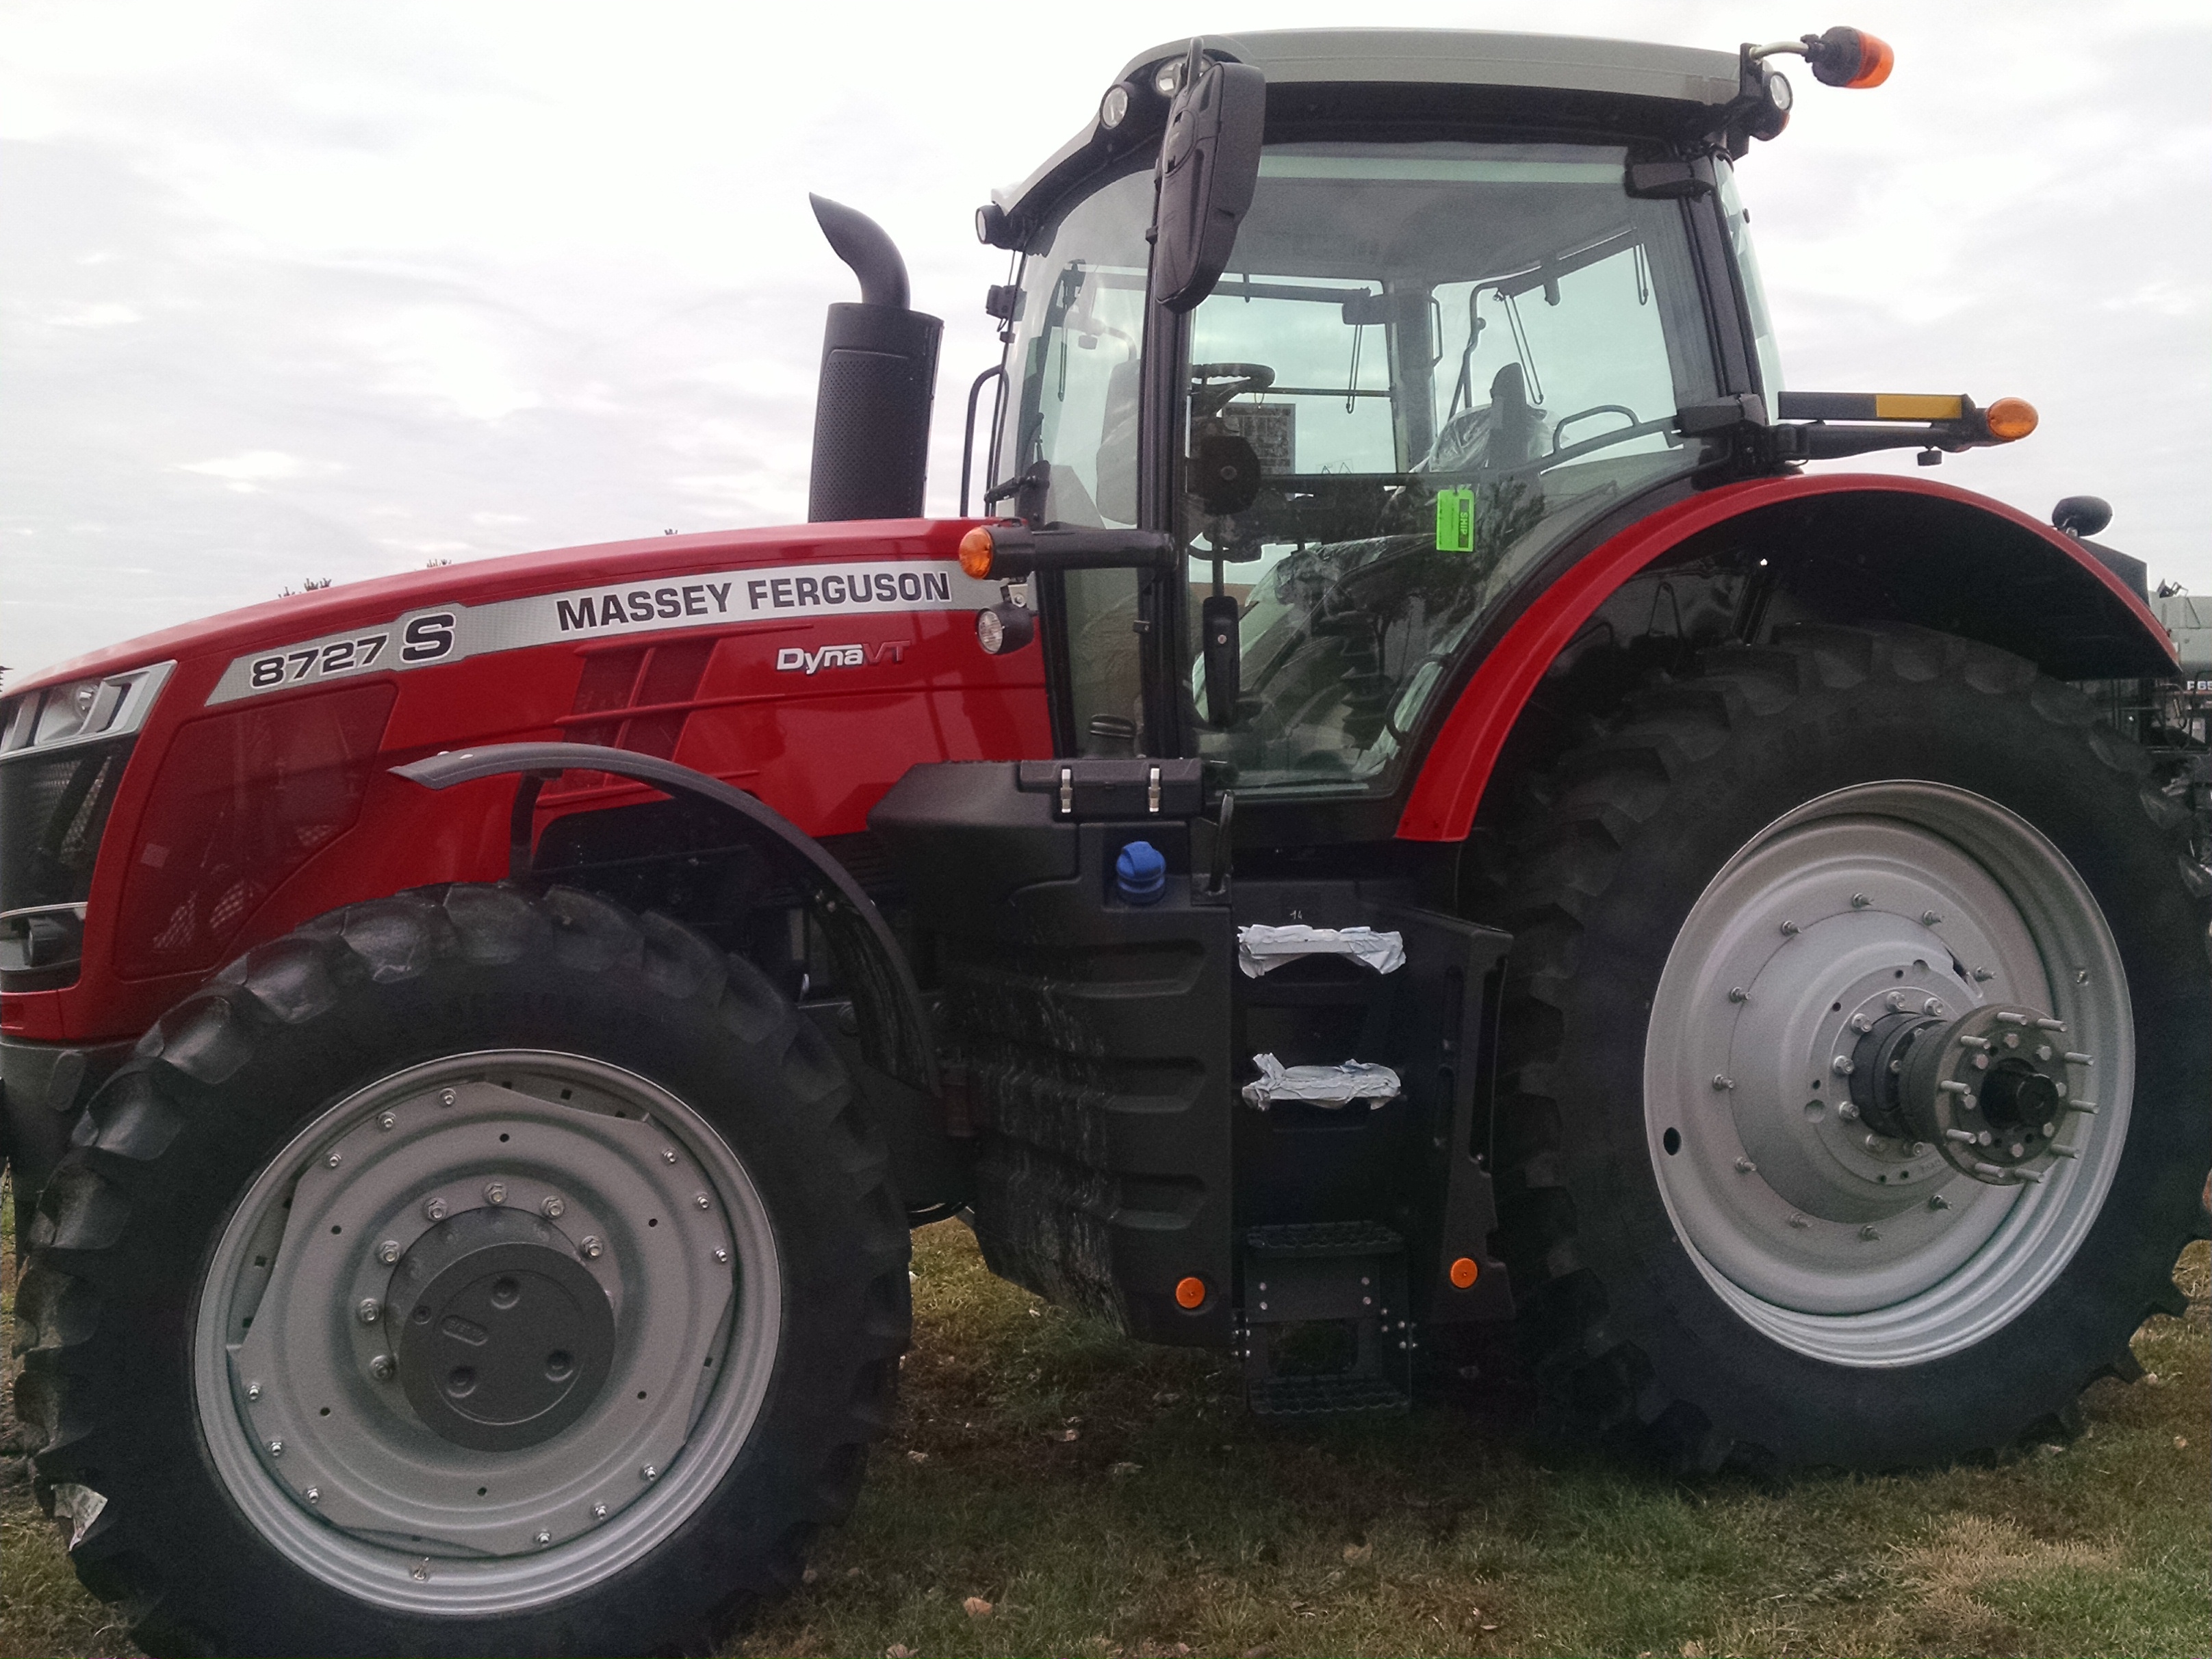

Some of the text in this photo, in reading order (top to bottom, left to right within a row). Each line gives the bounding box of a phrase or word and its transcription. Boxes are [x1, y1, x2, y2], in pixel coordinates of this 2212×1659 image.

[1460, 512, 1468, 535] SHIP
[556, 572, 951, 631] MASSEY FERGUSON
[251, 613, 455, 689] 8727 S
